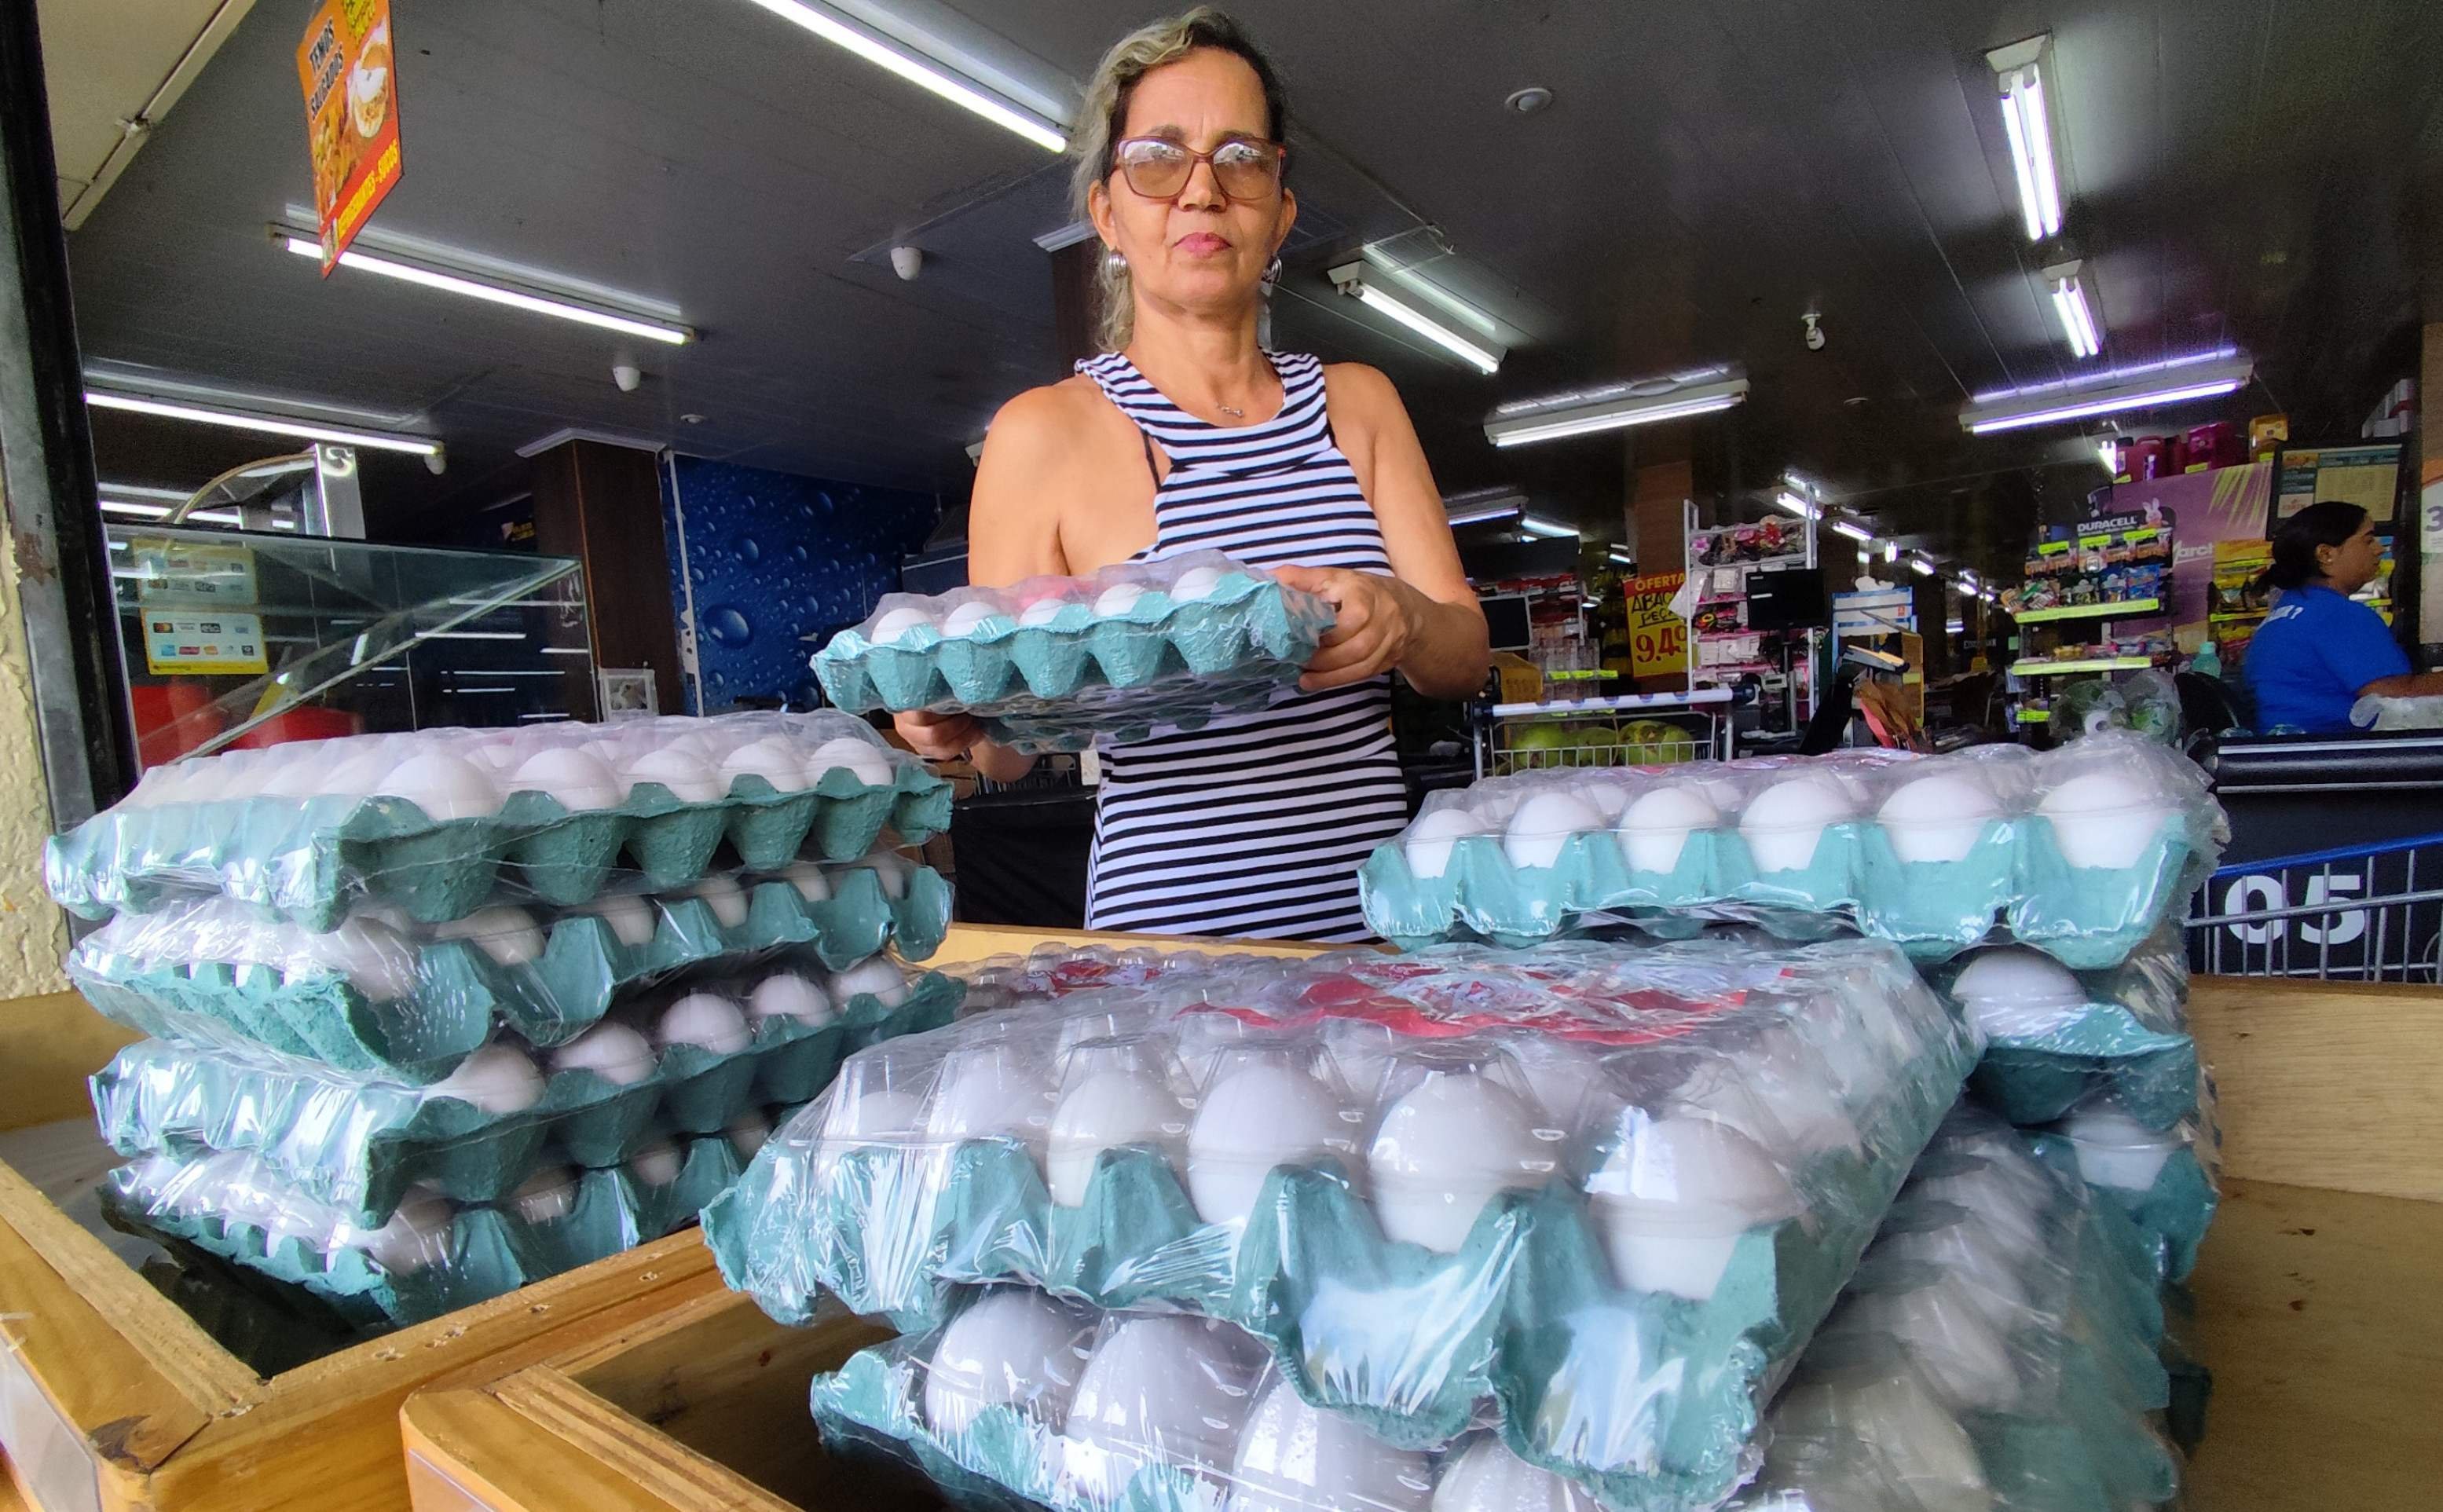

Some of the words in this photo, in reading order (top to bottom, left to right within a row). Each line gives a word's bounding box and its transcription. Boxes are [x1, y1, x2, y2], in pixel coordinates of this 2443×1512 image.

[2076, 516, 2137, 533] DURACELL
[1635, 573, 1685, 591] OFERTA
[1632, 591, 1676, 614] ABAC
[2225, 874, 2365, 945] 05
